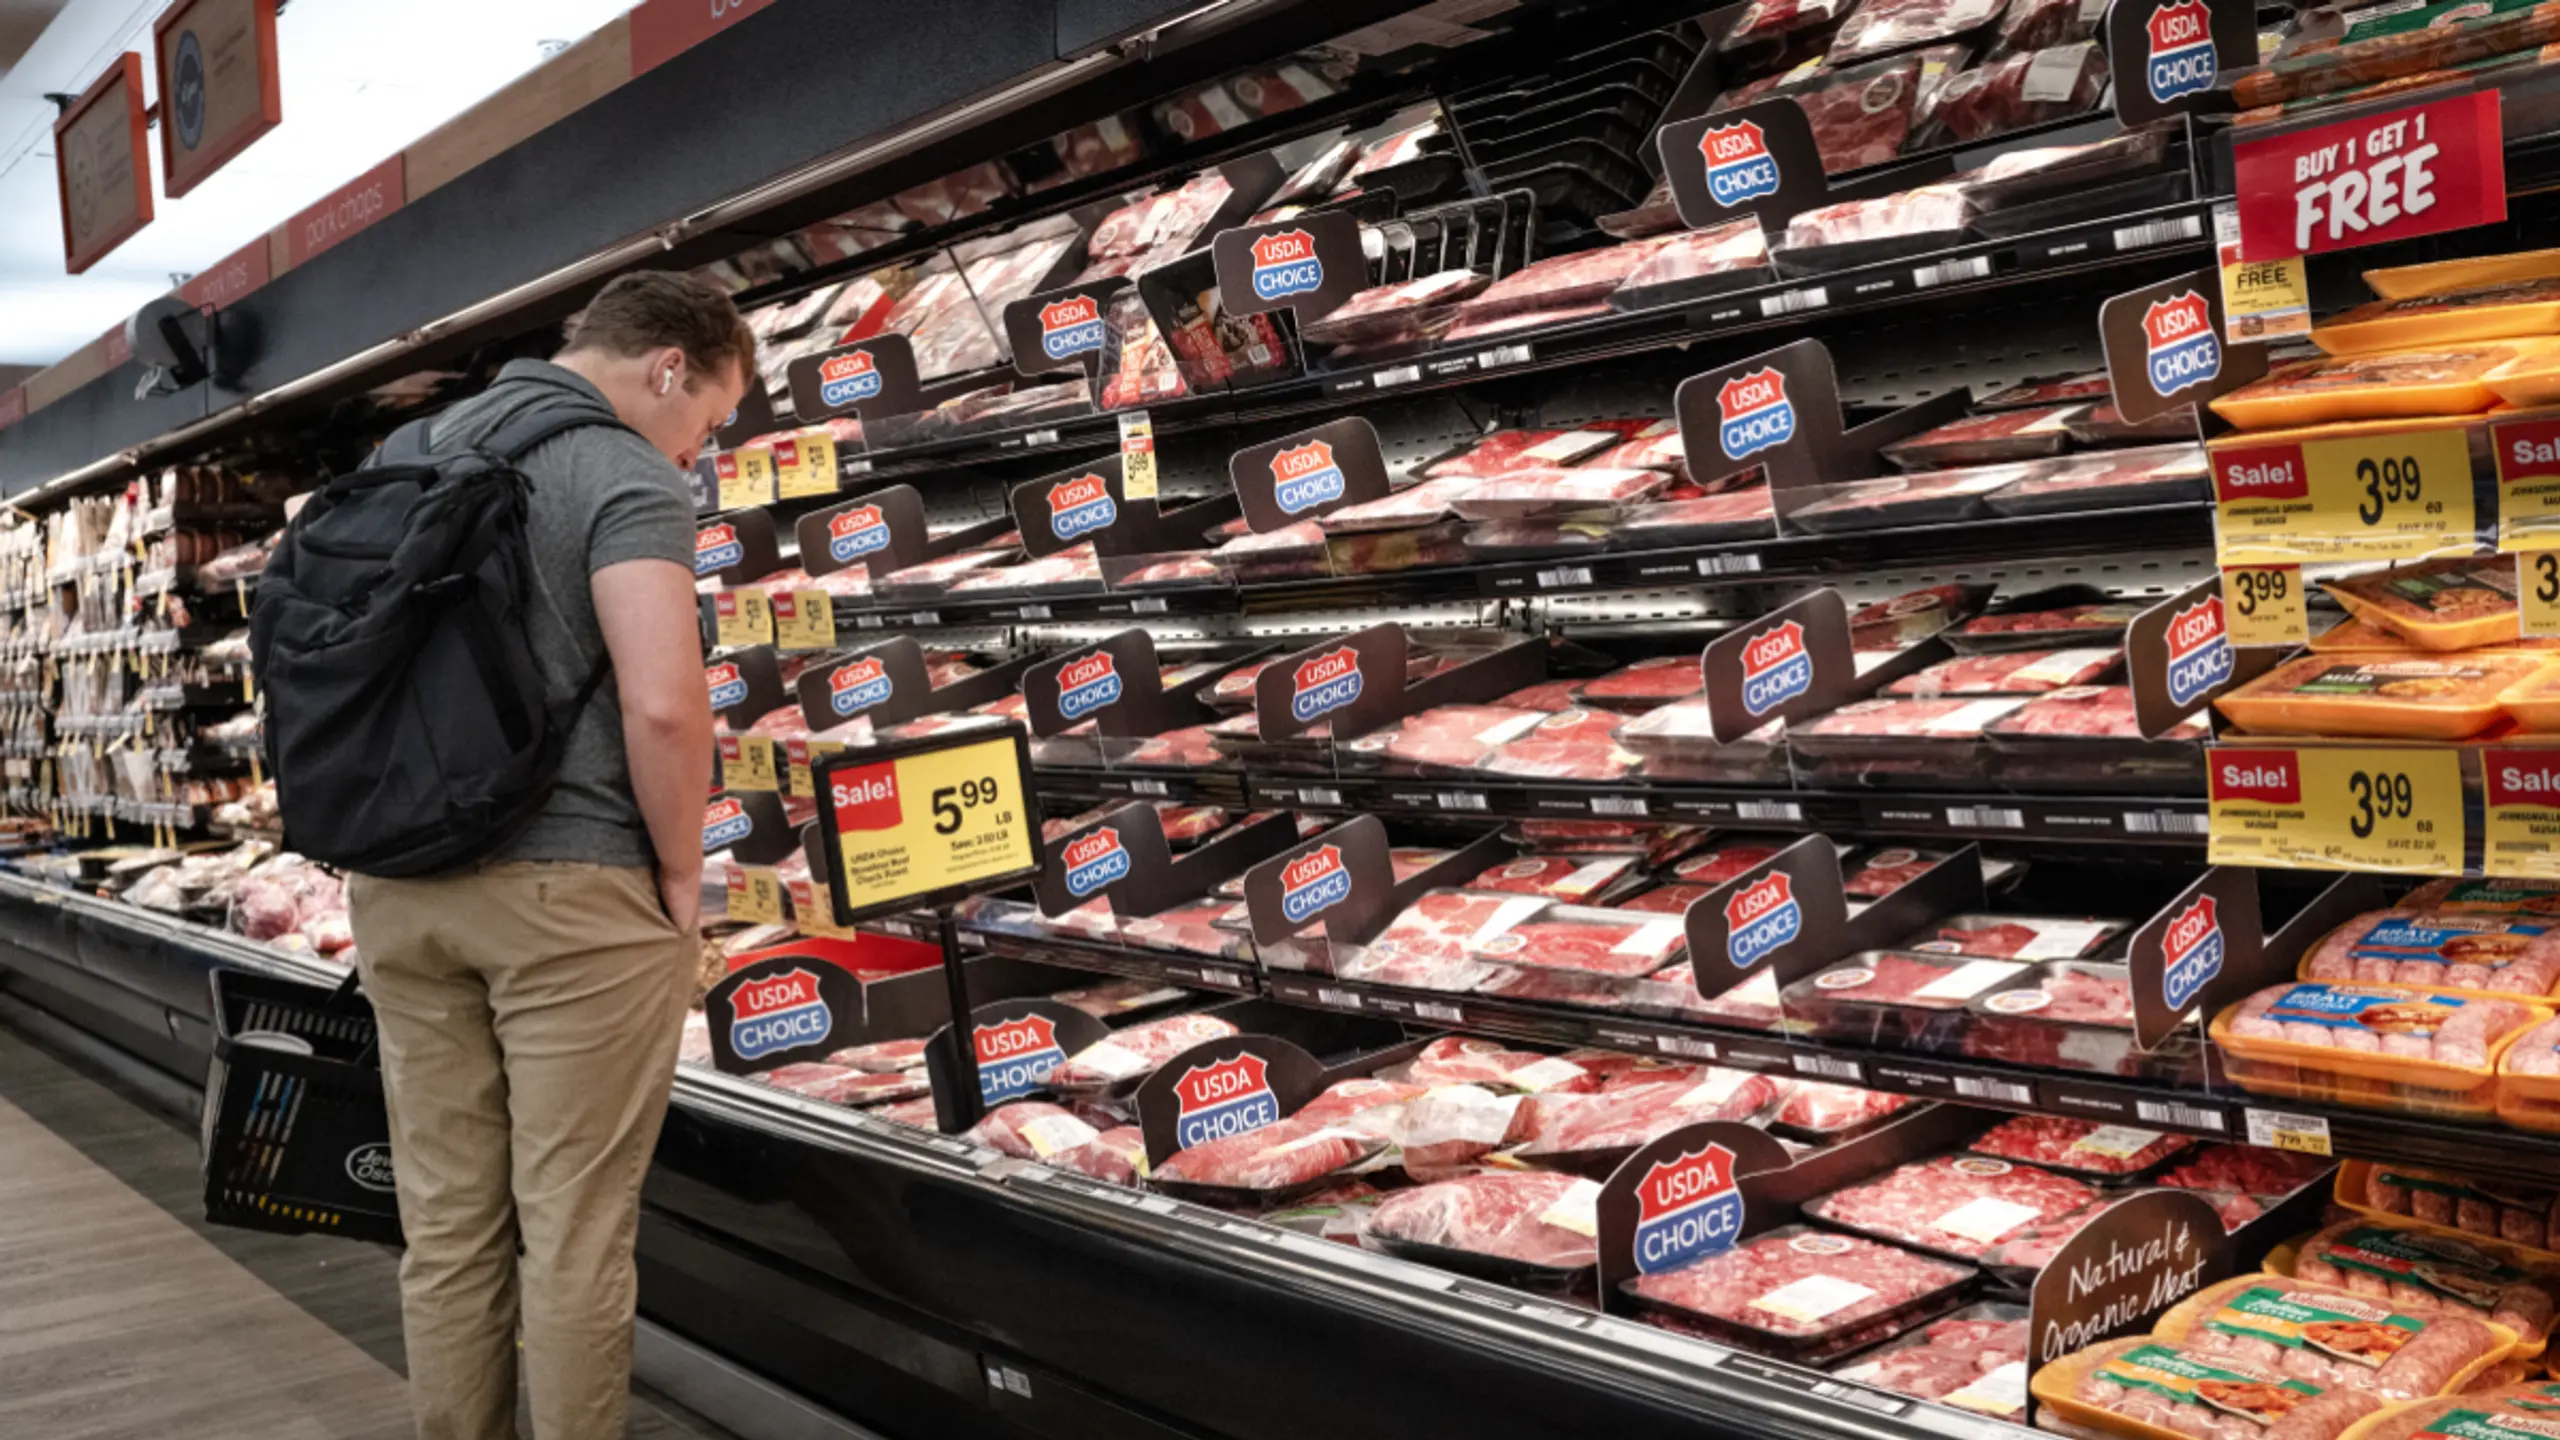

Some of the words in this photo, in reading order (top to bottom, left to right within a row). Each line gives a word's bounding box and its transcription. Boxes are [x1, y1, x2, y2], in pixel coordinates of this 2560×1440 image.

[2161, 16, 2200, 43] USDA
[2155, 54, 2211, 87] CHOICE
[1713, 137, 1754, 160] USDA
[2295, 144, 2339, 183] BUY
[2346, 137, 2357, 164] 1
[2366, 120, 2407, 157] GET
[2415, 113, 2427, 141] 1
[1714, 163, 1773, 195] CHOICE
[2295, 143, 2439, 250] FREE
[306, 219, 336, 247] pork
[340, 183, 382, 228] chops
[1264, 240, 1305, 260] USDA
[1260, 265, 1317, 291] CHOICE
[2237, 266, 2288, 288] FREE
[1050, 304, 1088, 324] USDA
[2156, 309, 2199, 338] USDA
[1050, 327, 1101, 351] CHOICE
[830, 359, 865, 376] USDA
[2155, 346, 2216, 382] CHOICE
[828, 377, 876, 399] CHOICE
[1731, 382, 1773, 409] USDA
[1728, 414, 1789, 446] CHOICE
[1283, 452, 1323, 473] USDA
[2228, 461, 2295, 488] Sale!
[1060, 485, 1097, 504] USDA
[1282, 474, 1339, 504] CHOICE
[840, 513, 873, 530] USDA
[1057, 507, 1112, 531] CHOICE
[2426, 501, 2443, 514] ea
[836, 532, 885, 554] CHOICE
[2177, 616, 2216, 646] USDA
[1754, 635, 1794, 664] USDA
[707, 668, 730, 681] SDA
[840, 665, 874, 683] USDA
[1067, 662, 1103, 684] USDA
[1306, 656, 1347, 682] USDA
[1750, 663, 1806, 703] CHOICE
[2174, 647, 2229, 691] CHOICE
[837, 684, 887, 707] CHOICE
[1064, 684, 1116, 711] CHOICE
[1300, 682, 1356, 711] CHOICE
[2223, 765, 2288, 788] Sale!
[831, 775, 894, 809] Sale!
[995, 811, 1012, 825] LB
[2417, 820, 2433, 833] ea
[1073, 841, 1110, 860] USDA
[1071, 858, 1124, 888] CHOICE
[1292, 856, 1331, 882] USDA
[1289, 878, 1344, 914] CHOICE
[1738, 884, 1779, 915] USDA
[1734, 914, 1793, 956] CHOICE
[2172, 915, 2206, 950] USDA
[2170, 942, 2218, 996] CHOICE
[747, 982, 804, 1010] USDA
[740, 1011, 823, 1045] CHOICE
[981, 1027, 1041, 1055] USDA
[1194, 1066, 1252, 1101] USDA
[1187, 1103, 1271, 1144] CHOICE
[1657, 1165, 1718, 1206] USDA
[1645, 1208, 1735, 1260] CHOICE
[2068, 1220, 2172, 1304] Natural
[2175, 1221, 2190, 1262] &
[2041, 1294, 2139, 1362] Organic
[2142, 1248, 2207, 1315] Meat
